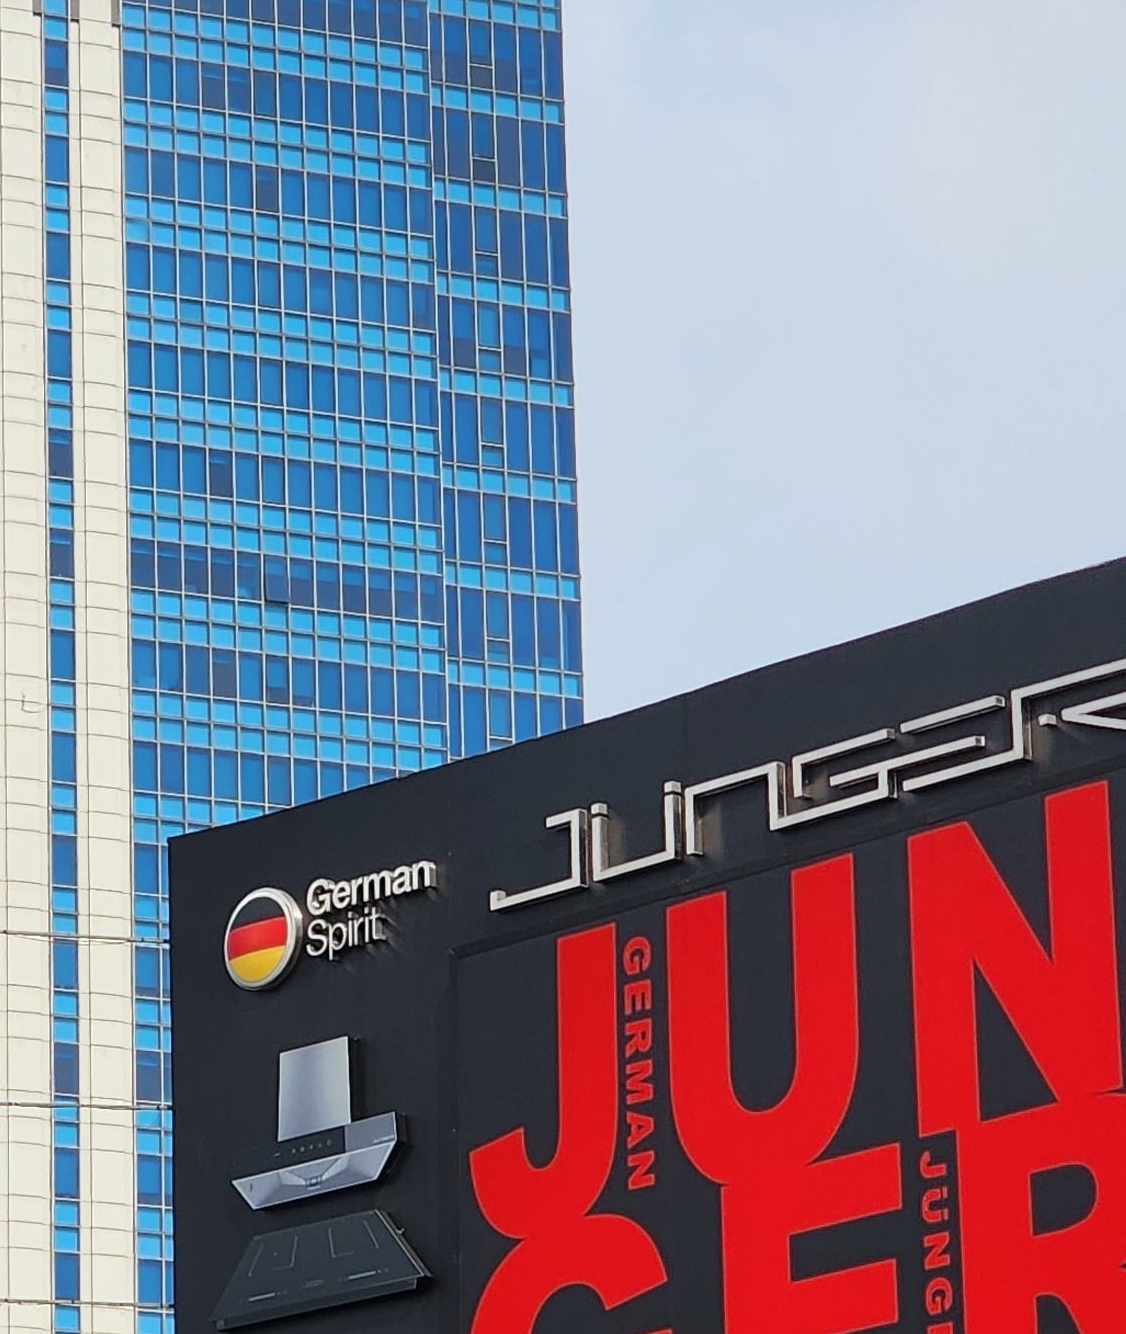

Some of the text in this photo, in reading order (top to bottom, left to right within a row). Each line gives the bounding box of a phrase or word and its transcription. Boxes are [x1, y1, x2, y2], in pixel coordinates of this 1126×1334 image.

[306, 860, 437, 916] German
[306, 907, 386, 961] Spirit
[622, 936, 655, 1190] GERMAN
